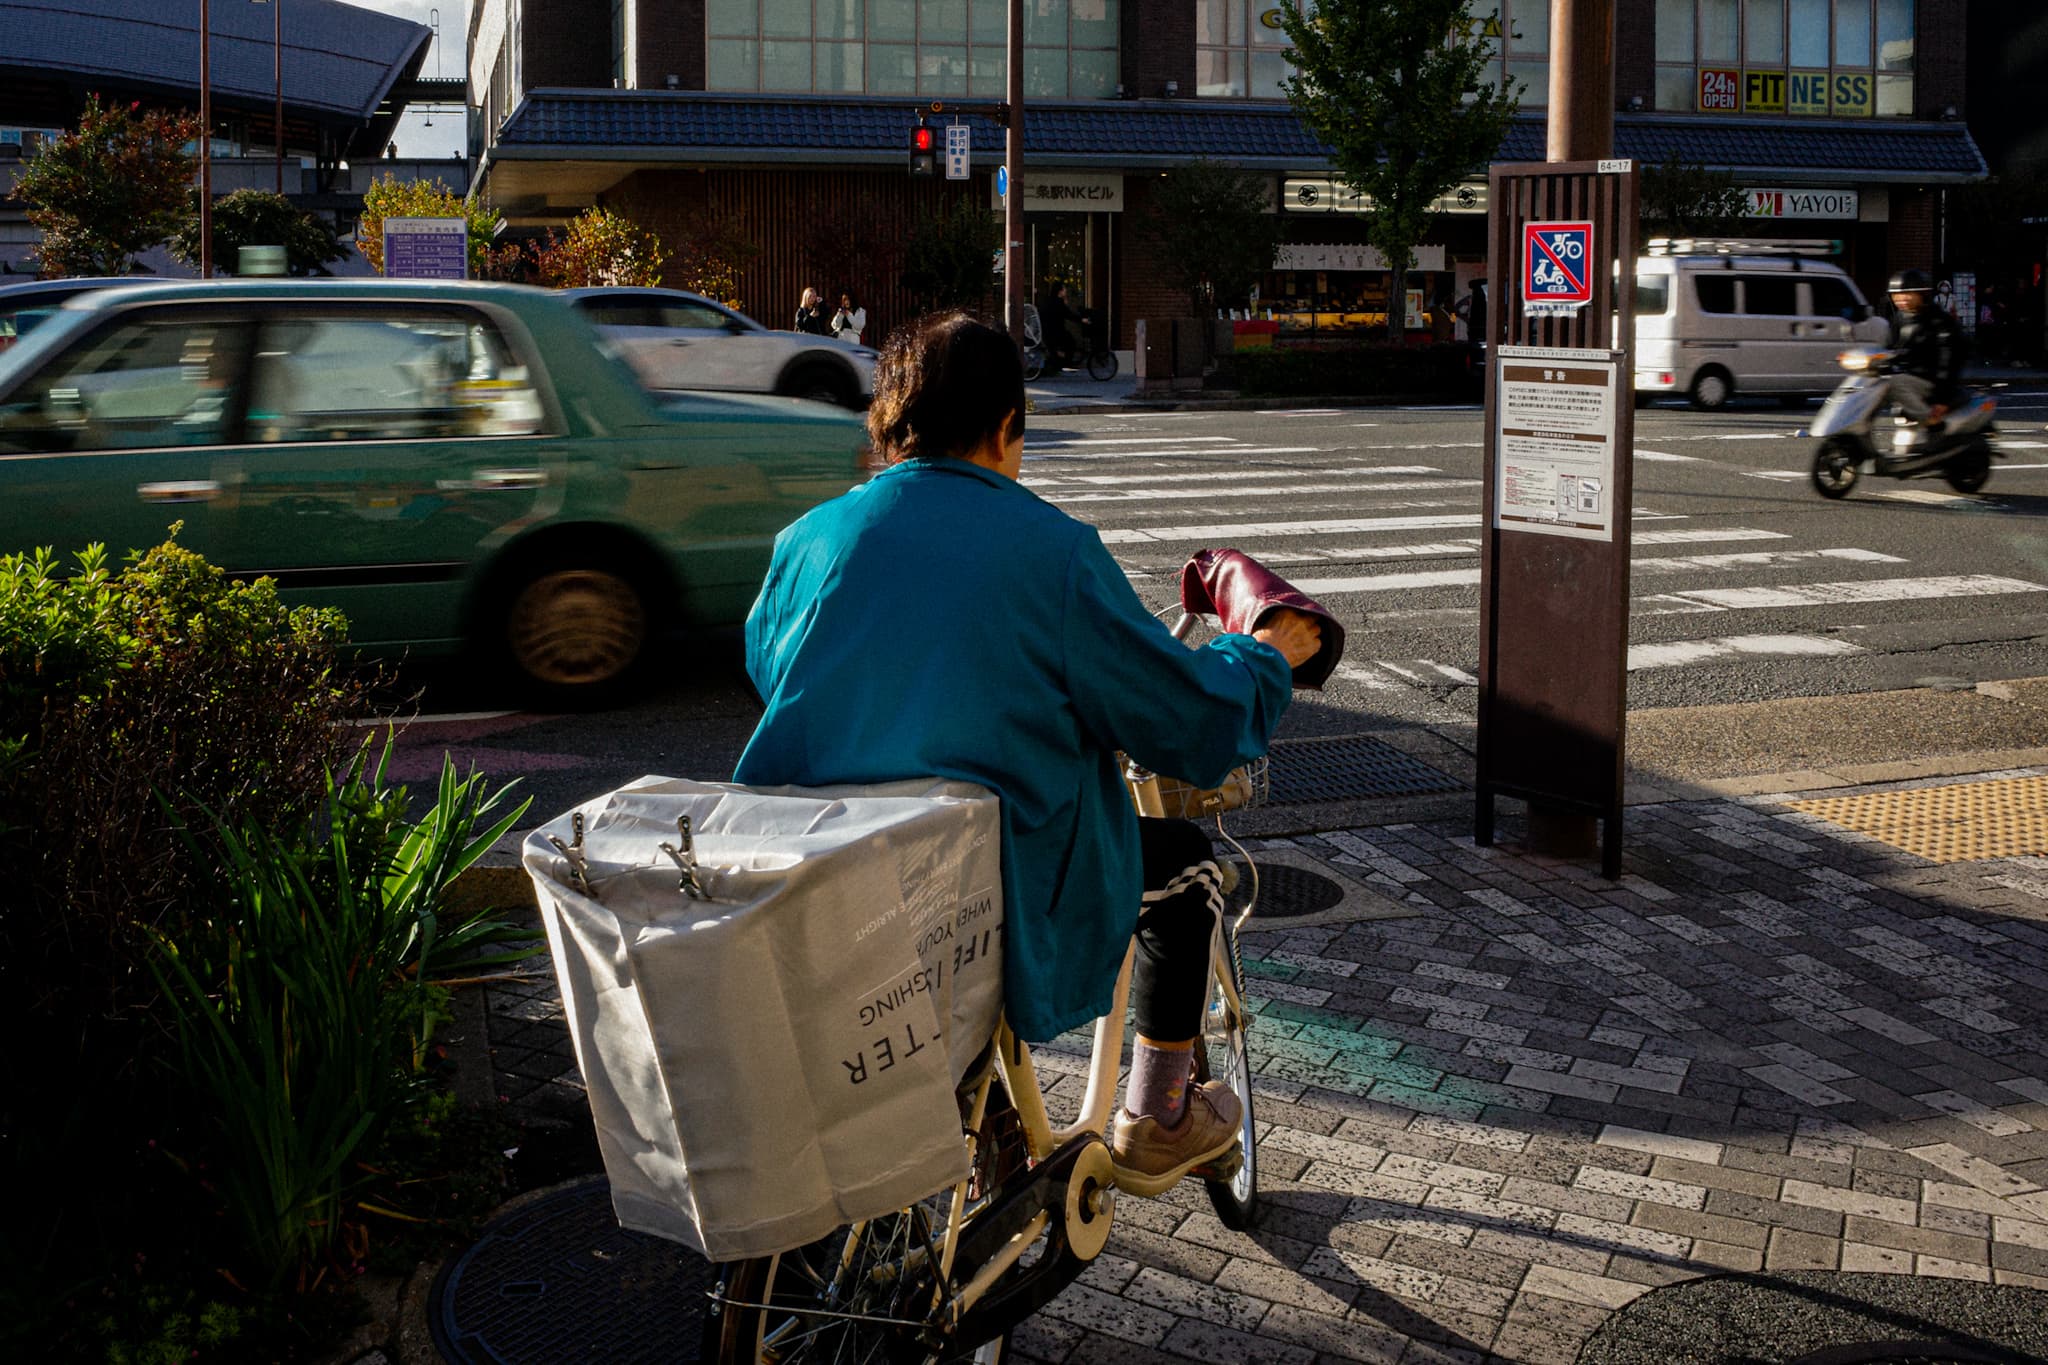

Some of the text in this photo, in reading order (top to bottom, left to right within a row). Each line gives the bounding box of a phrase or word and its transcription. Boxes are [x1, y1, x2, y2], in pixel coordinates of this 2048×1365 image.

[1703, 72, 1736, 94] 24h
[1703, 93, 1735, 109] OPEN
[1600, 161, 1630, 171] 64-17
[1789, 194, 1844, 213] YAYOI
[859, 971, 928, 1026] GHING
